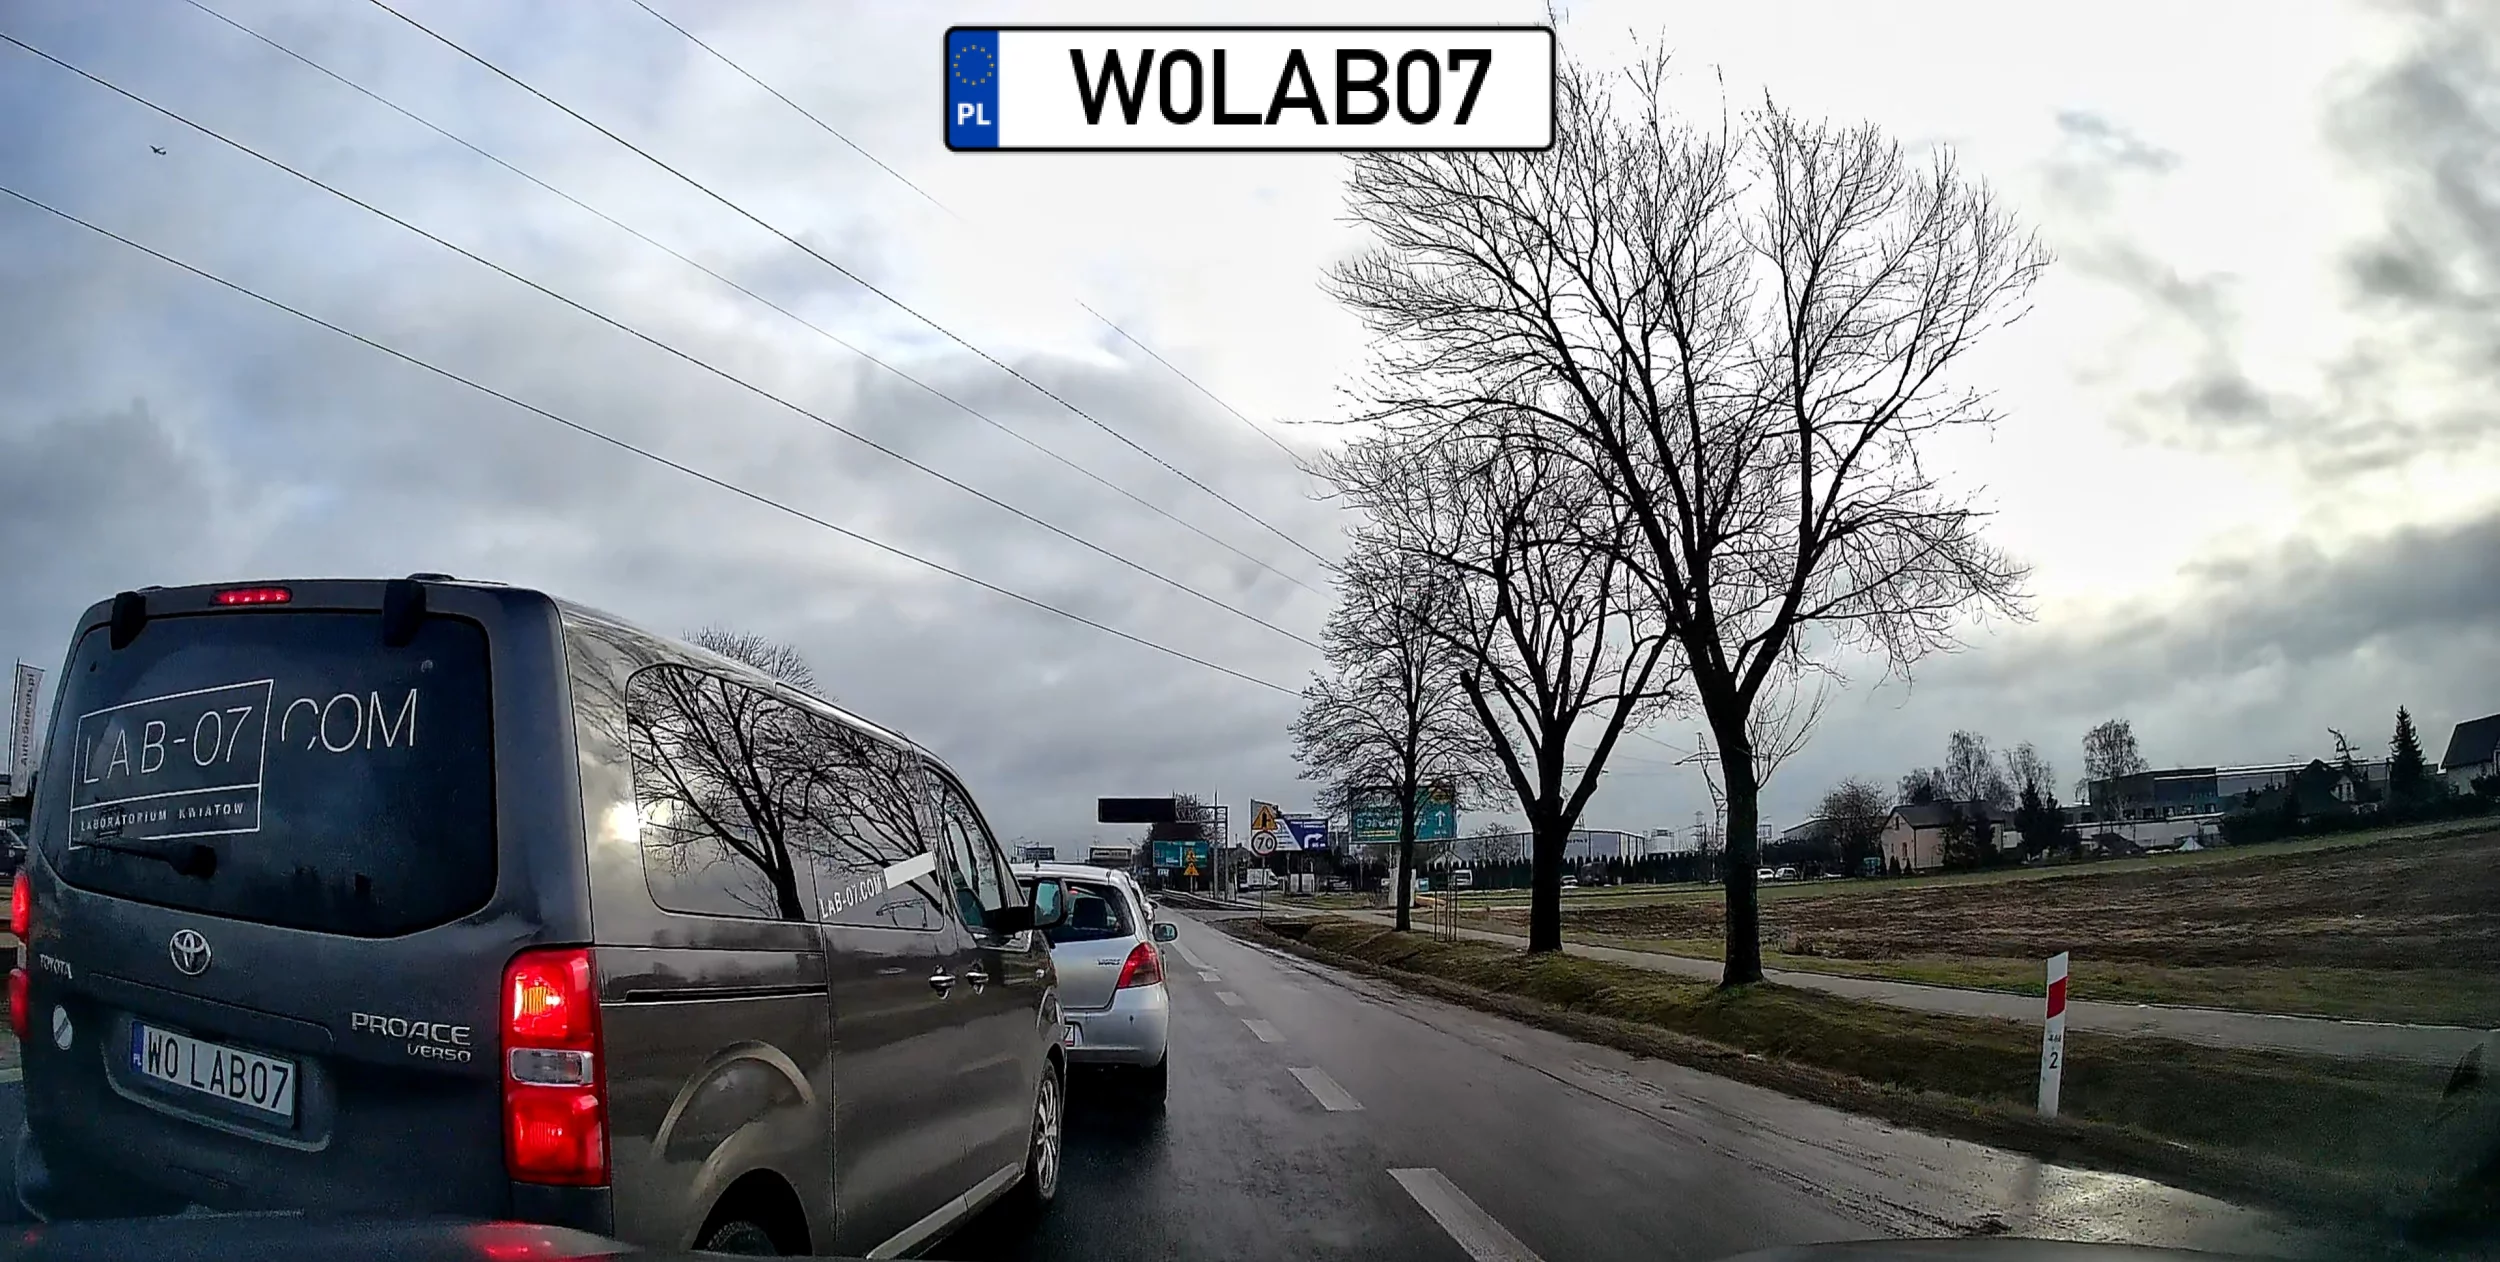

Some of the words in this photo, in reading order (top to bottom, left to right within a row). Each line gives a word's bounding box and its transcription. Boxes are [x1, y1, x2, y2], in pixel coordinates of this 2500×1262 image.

[83, 705, 253, 784] LAB-07
[80, 808, 168, 832] LABORATORIUM
[1257, 836, 1274, 850] 70
[819, 875, 883, 919] LAB-07.COM
[39, 953, 73, 980] TOYOTA
[351, 1011, 471, 1046] PROACE
[132, 1052, 142, 1067] PL
[407, 1043, 471, 1063] VERSO
[2049, 1051, 2059, 1070] 2
[190, 1043, 289, 1109] LAB07
